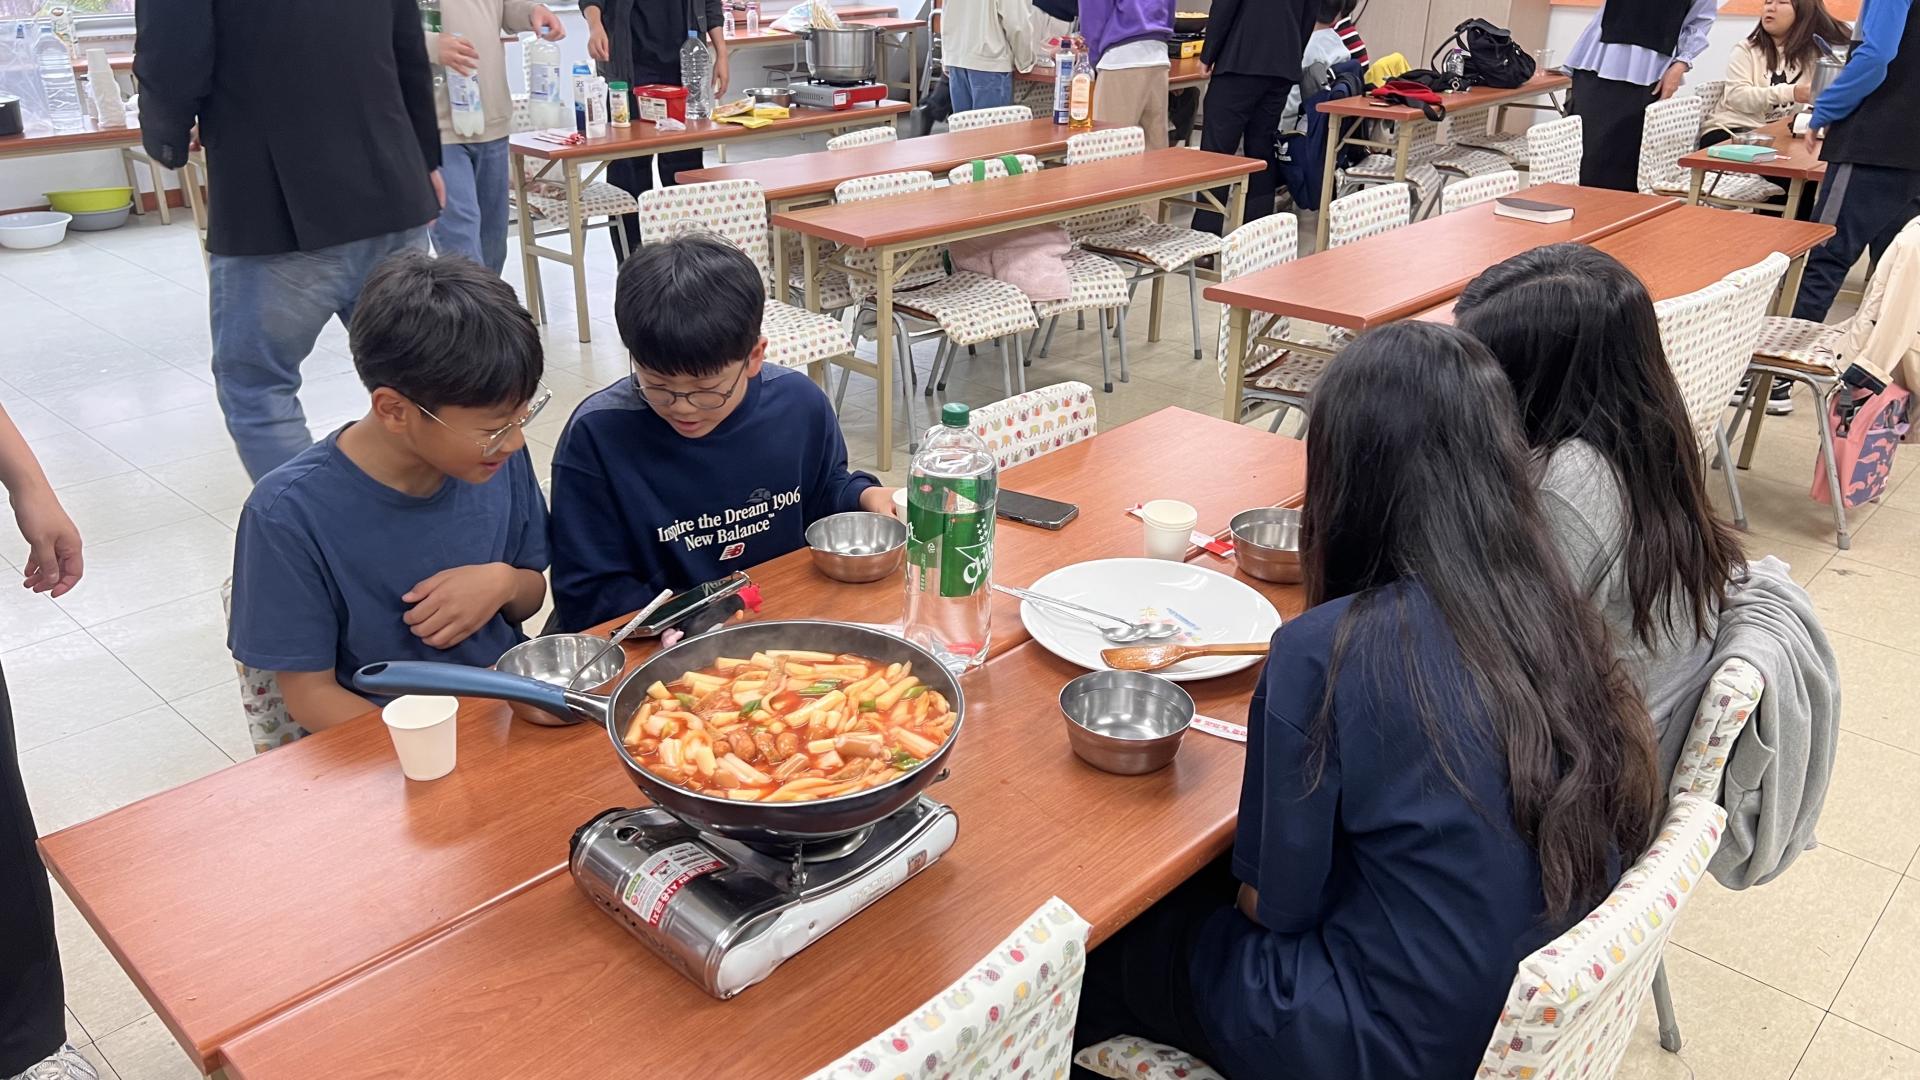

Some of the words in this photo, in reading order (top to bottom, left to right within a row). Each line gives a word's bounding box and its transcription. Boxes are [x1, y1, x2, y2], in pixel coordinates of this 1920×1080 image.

[698, 513, 722, 529] the
[724, 501, 769, 525] Dream
[772, 485, 801, 511] 1906
[684, 534, 714, 551] New
